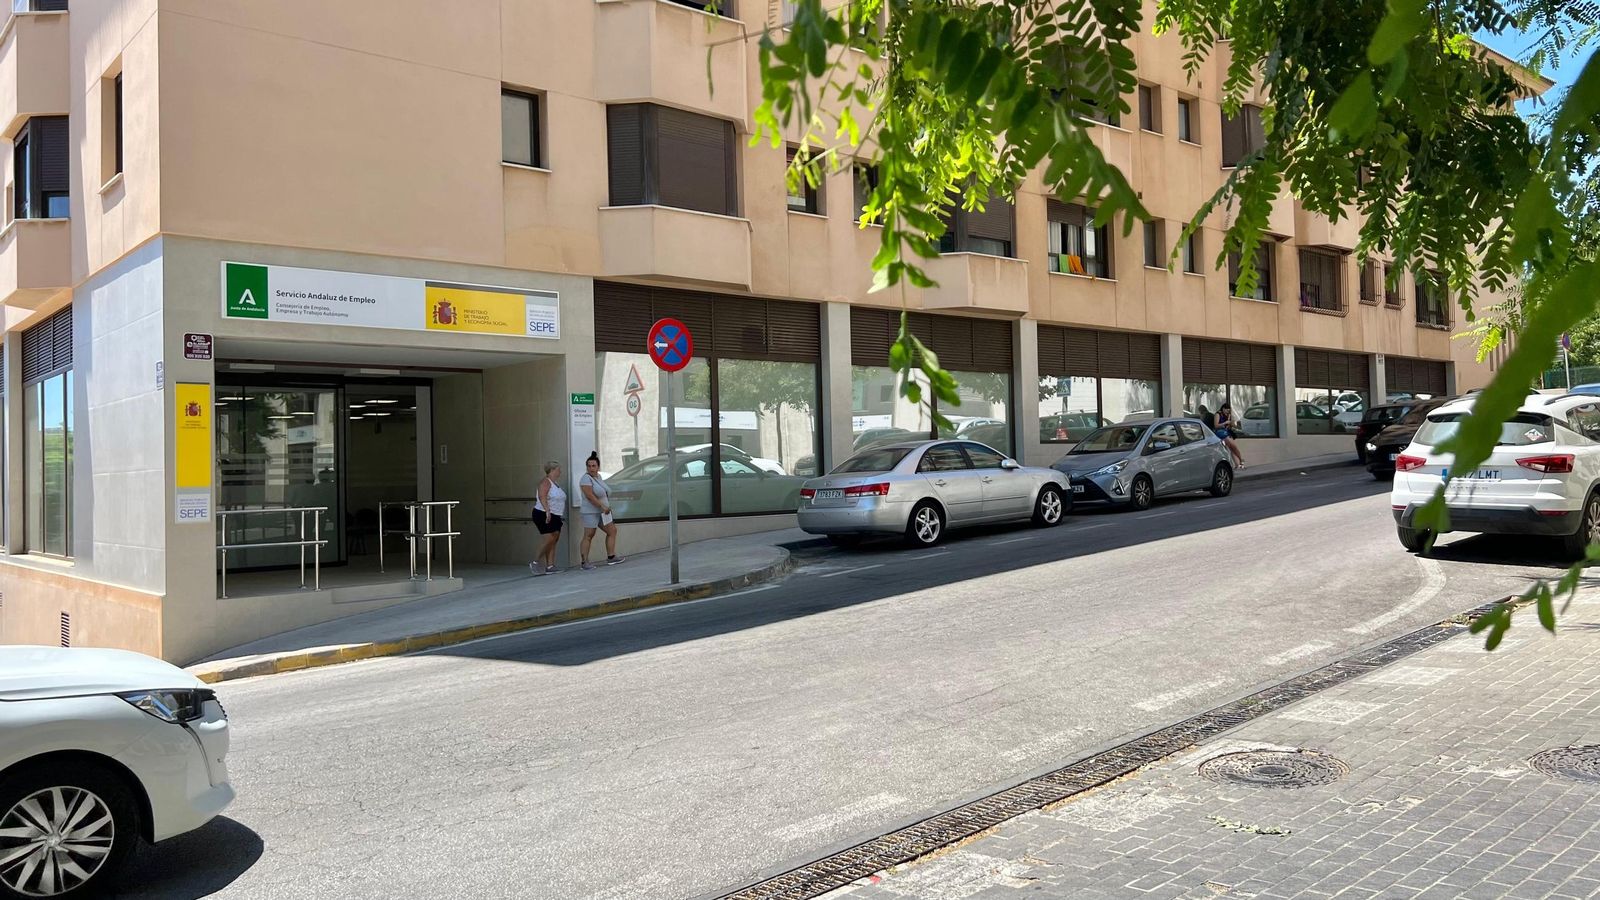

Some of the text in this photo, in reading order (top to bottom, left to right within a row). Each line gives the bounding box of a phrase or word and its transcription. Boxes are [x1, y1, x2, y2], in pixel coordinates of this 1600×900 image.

[276, 290, 307, 299] Servicio
[308, 292, 337, 301] Andaluz
[350, 296, 376, 304] Empleo
[276, 302, 303, 310] Consejería
[530, 321, 555, 332] SEPE
[1478, 470, 1499, 479] LMT
[180, 509, 207, 518] SEPE
